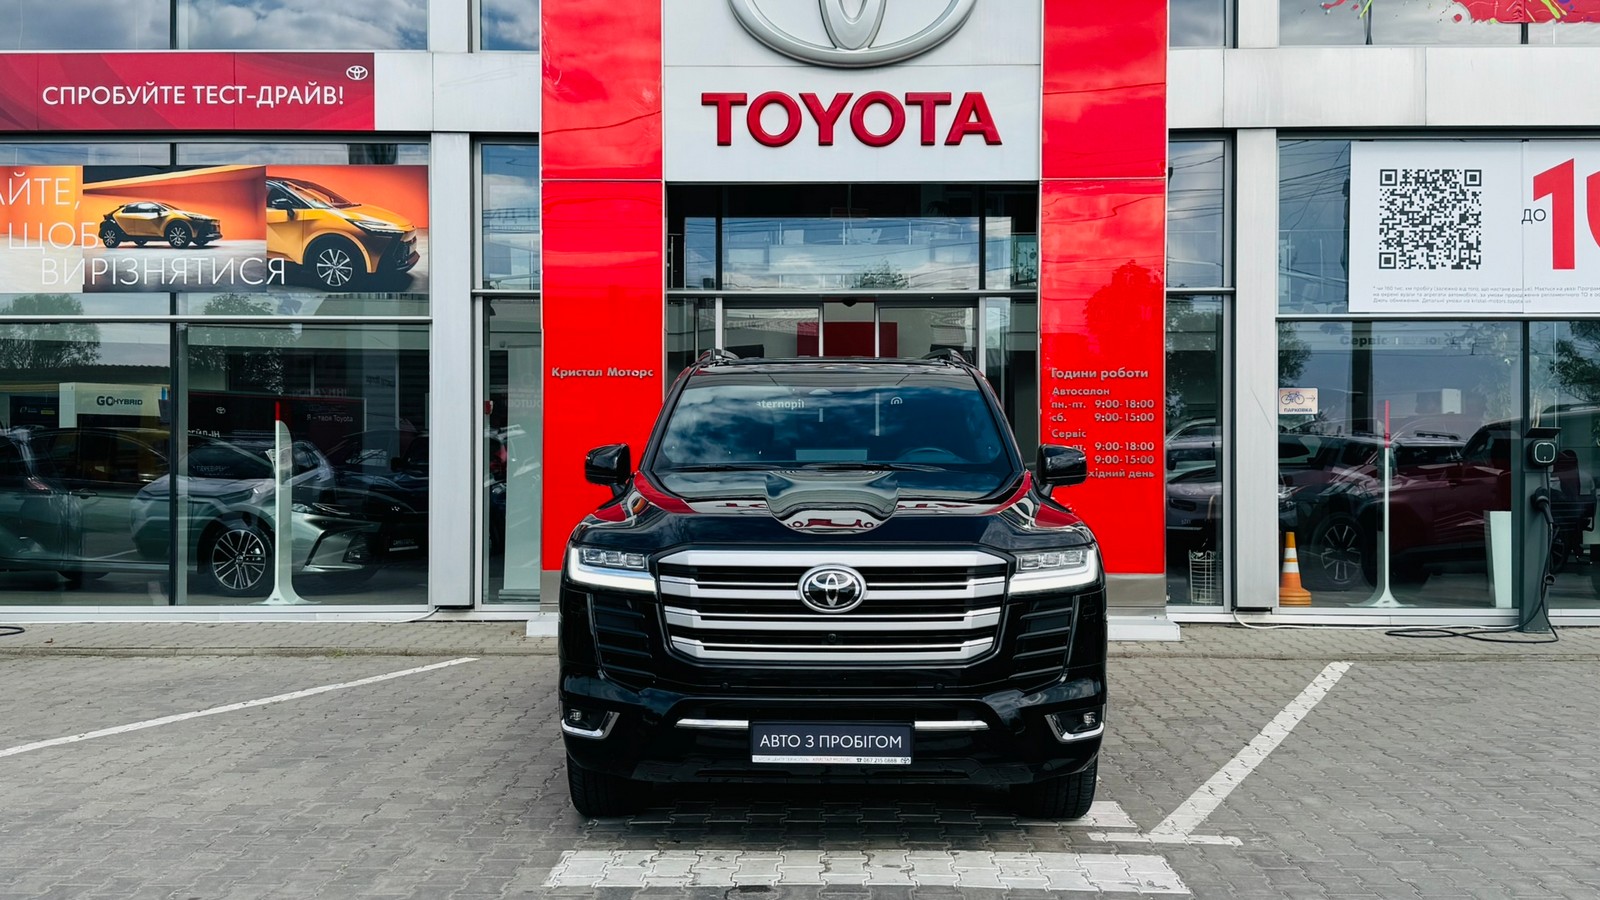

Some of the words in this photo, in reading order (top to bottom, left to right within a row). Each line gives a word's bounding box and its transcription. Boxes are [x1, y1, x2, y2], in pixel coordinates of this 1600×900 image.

[42, 81, 186, 106] СПРОБУЙТЕ
[192, 81, 344, 109] ТЕСТ-ДРАЙВ!
[701, 90, 1003, 148] TOYOTA
[1521, 208, 1547, 225] ДО
[1533, 158, 1600, 269] 1
[9, 222, 99, 255] ЩОБ
[41, 257, 286, 286] ВИРІЗНЯТИСЯ
[551, 367, 603, 379] Кристал
[607, 367, 654, 379] Моторс
[1051, 367, 1097, 379] Години
[1100, 367, 1149, 381] роботи
[1052, 387, 1110, 396] Автосалон
[333, 414, 354, 423] Toyota
[1051, 412, 1067, 422] сб.
[1051, 428, 1087, 440] Сервіс
[1088, 468, 1126, 478] хідний
[759, 734, 802, 748] АВТО
[805, 734, 815, 748] З
[819, 734, 902, 749] ПРОБІГОМ
